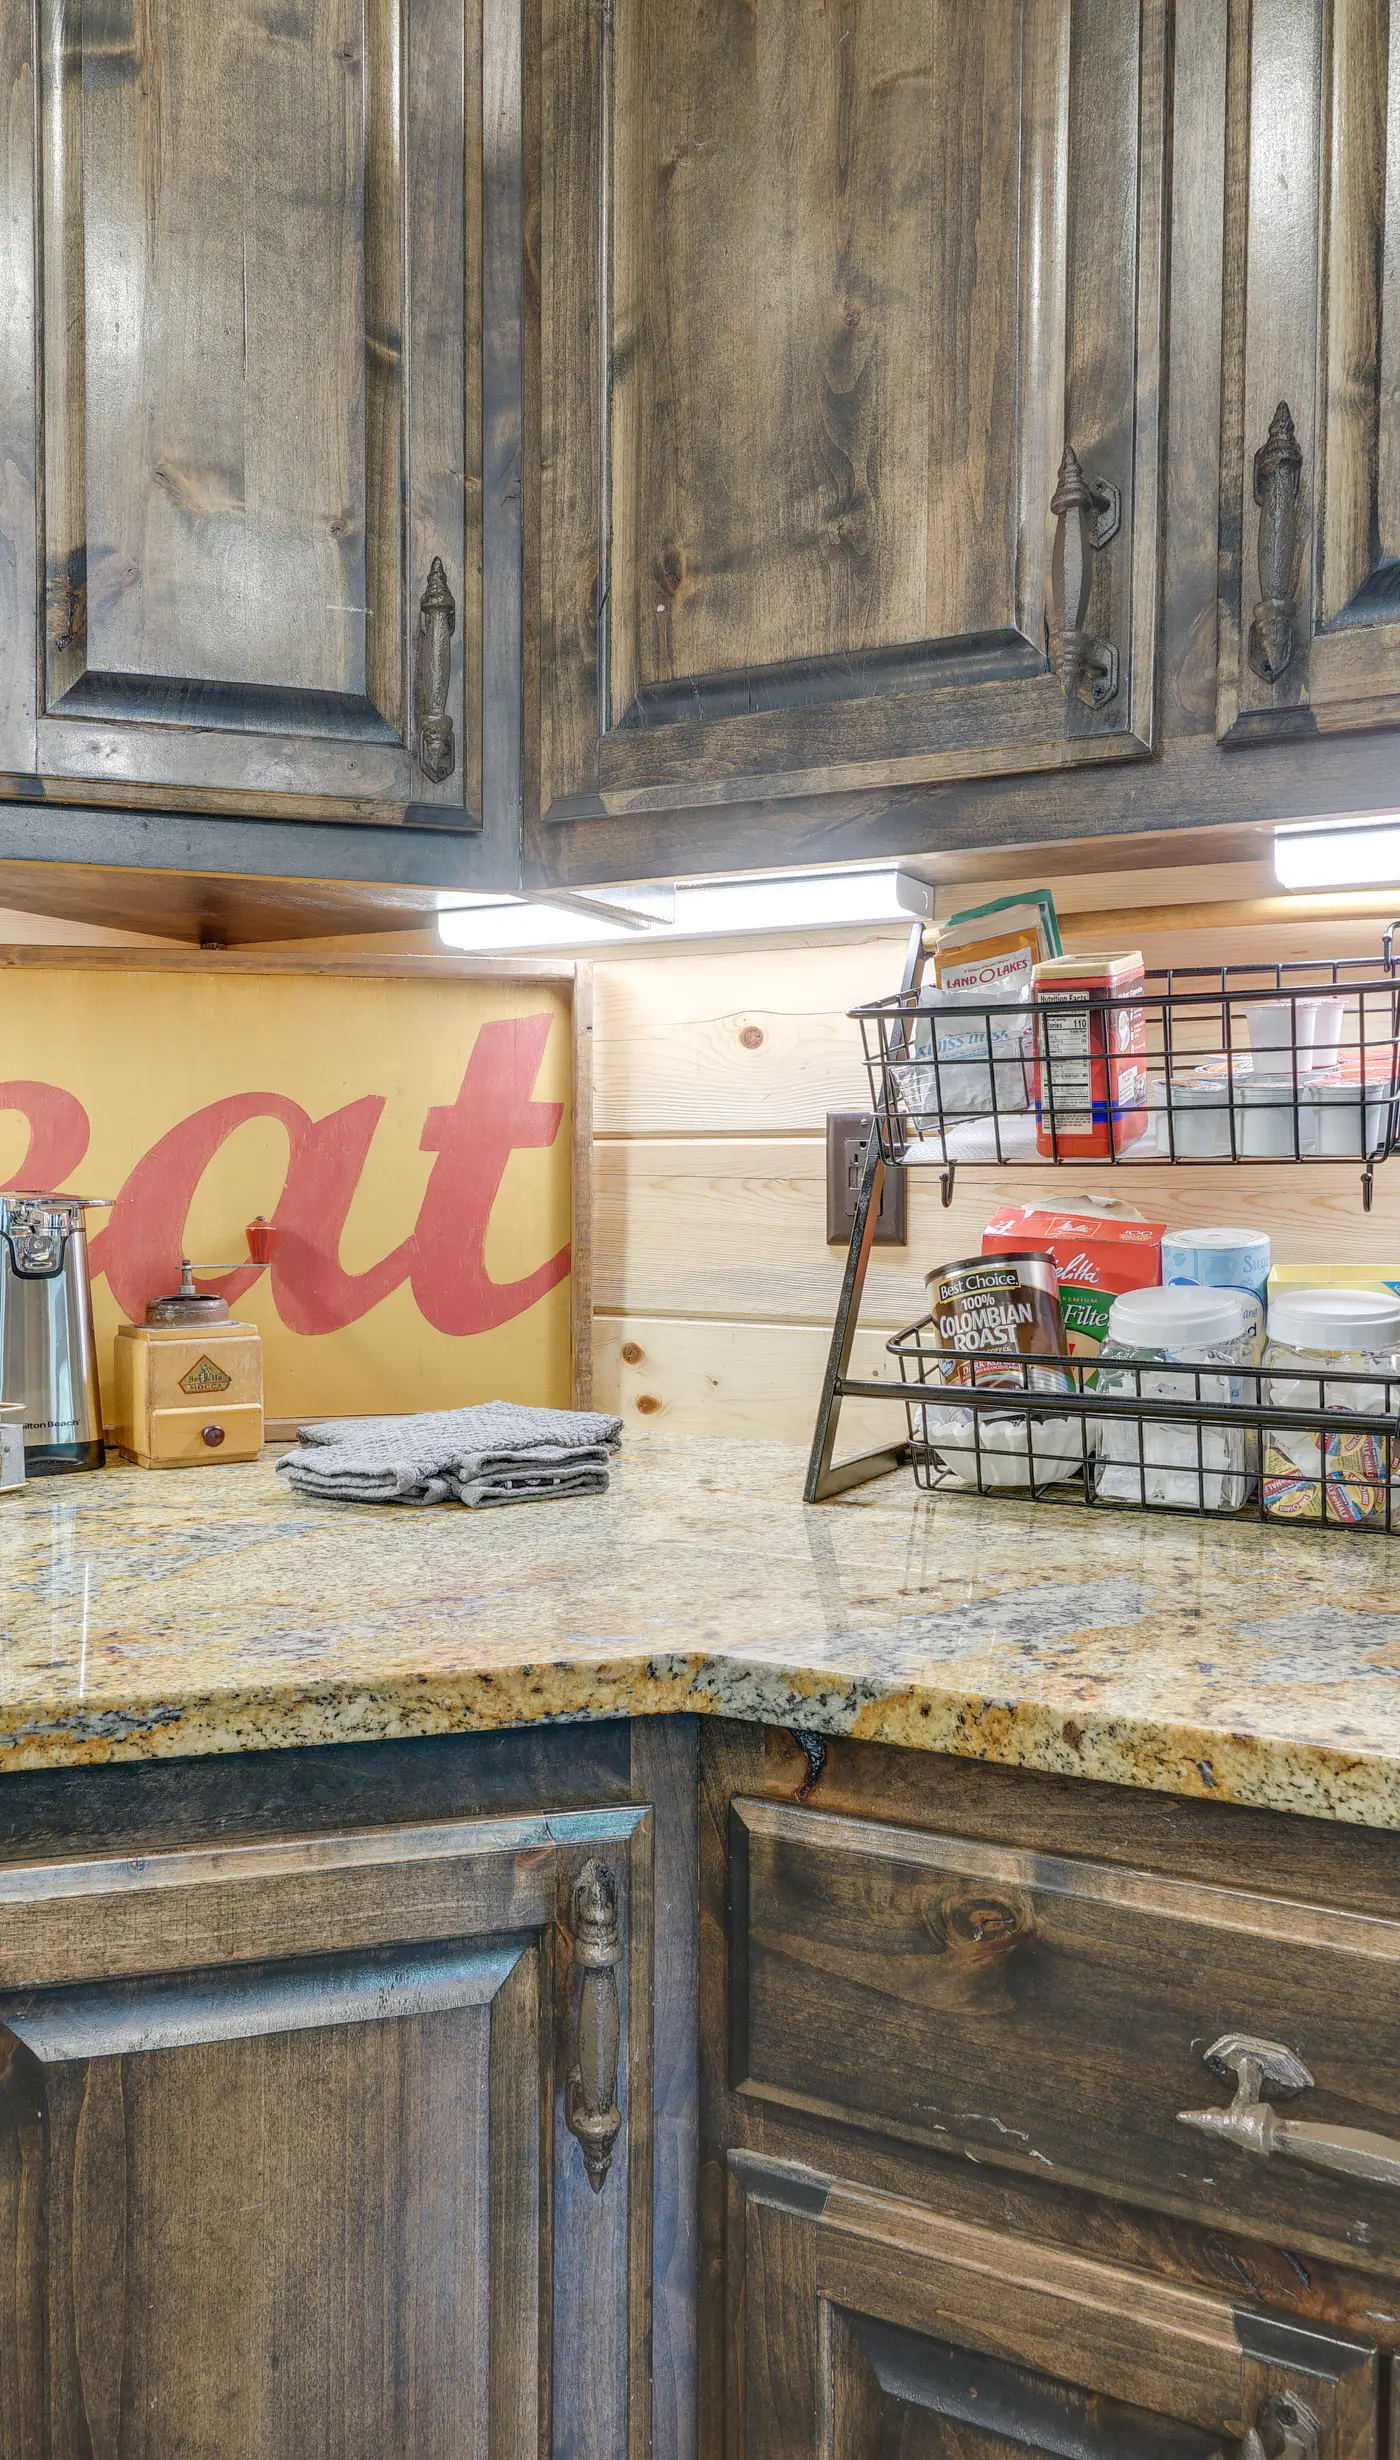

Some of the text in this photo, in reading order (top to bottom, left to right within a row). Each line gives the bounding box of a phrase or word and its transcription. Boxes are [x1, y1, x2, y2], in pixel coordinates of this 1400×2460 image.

[947, 975, 977, 989] LAND
[979, 968, 996, 983] O
[997, 959, 1028, 977] LAKES
[1040, 994, 1068, 1003] Nutrition
[1073, 1019, 1087, 1028] 110
[1045, 1246, 1100, 1284] elitta
[940, 1280, 965, 1300] Best
[961, 1293, 996, 1311] 100%
[940, 1303, 1034, 1339] COLOMBIAN
[1064, 1304, 1110, 1327] Filte
[1243, 1307, 1258, 1319] ane
[953, 1324, 1019, 1351] ROAST
[47, 1420, 79, 1428] Beach
